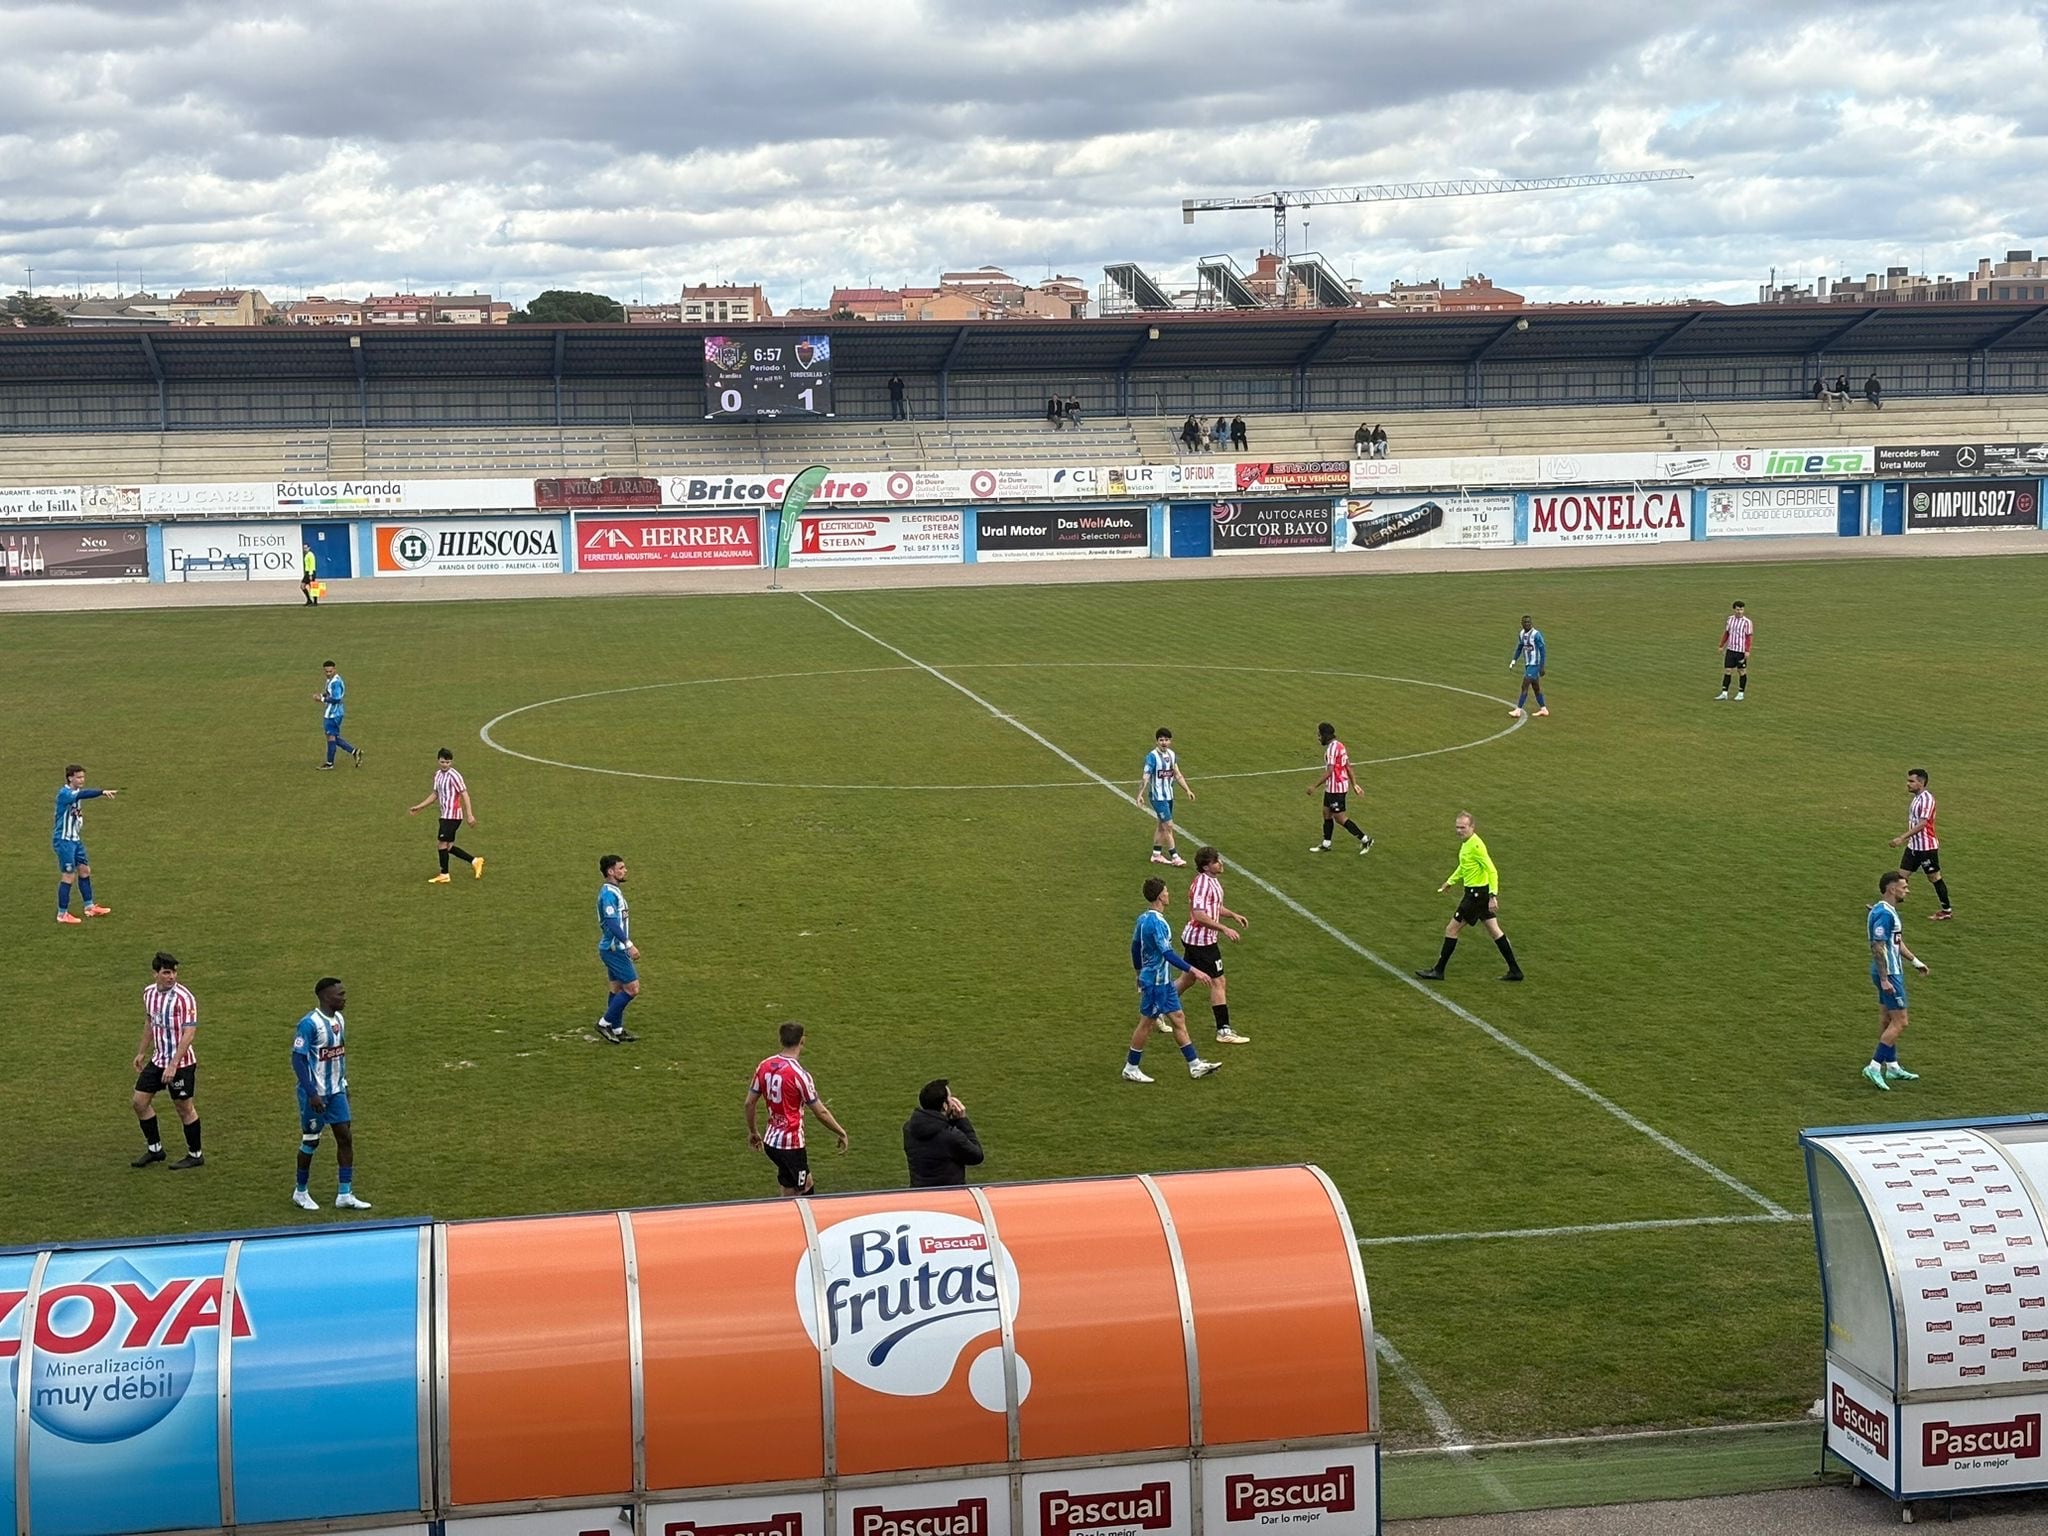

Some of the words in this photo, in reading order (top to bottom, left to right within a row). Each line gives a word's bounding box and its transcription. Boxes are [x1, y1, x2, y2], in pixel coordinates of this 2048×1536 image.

[754, 348, 782, 361] 6:57
[720, 390, 742, 412] 0
[797, 388, 813, 410] 1
[1880, 449, 1940, 458] Mercedes-Benz
[1765, 451, 1863, 474] imesa
[1880, 461, 1901, 470] Ureta
[1903, 460, 1926, 469] Motor
[277, 481, 337, 496] Rótulos
[343, 480, 401, 496] Aranda
[1264, 476, 1295, 484] ROTULA
[687, 478, 868, 500] BricoCtro
[1742, 490, 1771, 507] SAN
[1776, 488, 1835, 506] GABRIEL
[1931, 490, 2016, 518] IMPULSO27
[28, 501, 43, 512] de
[1257, 509, 1328, 520] AUTOCARES
[1532, 493, 1685, 533] MONELCA
[1742, 510, 1769, 520] CIUDAD
[1771, 510, 1780, 519] DE
[1782, 510, 1793, 519] LA
[1794, 508, 1835, 519] EDUCACIÓN
[901, 514, 959, 523] ELECTRICIDAD
[1057, 518, 1079, 529] Das
[1472, 511, 1487, 523] TÚ
[922, 523, 959, 532] ESTEBAN
[981, 525, 1007, 537] Ural
[1010, 525, 1047, 537] Motor
[1218, 523, 1280, 537] VICTOR
[1284, 521, 1328, 536] BAYO
[1364, 507, 1430, 546] HERNANDO
[437, 530, 558, 557] HIESCOSA
[640, 525, 752, 547] HERRERA
[902, 533, 930, 541] MAYOR
[932, 532, 960, 540] HERAS
[1058, 533, 1079, 541] Audi
[1081, 532, 1120, 541] Selection
[1259, 536, 1267, 545] El
[1268, 536, 1282, 547] lujo
[1300, 536, 1327, 544] servicio
[625, 551, 662, 561] INDUSTRIAL
[670, 551, 703, 560] ALQUILER
[704, 551, 713, 559] DE
[713, 550, 753, 558] MAQUINARIA
[438, 563, 465, 571] ARANDA
[764, 1072, 783, 1104] 19
[797, 1170, 806, 1186] 19
[850, 1224, 912, 1279] Bi
[924, 1235, 982, 1250] Pascual
[826, 1261, 999, 1346] frutas
[45, 1356, 165, 1378] Mineralización
[36, 1386, 98, 1412] muy
[103, 1374, 173, 1403] débil
[1835, 1391, 1886, 1447] Pascual
[1846, 1432, 1856, 1443] Dar
[1855, 1437, 1861, 1447] lo
[1860, 1441, 1874, 1456] mejor
[1931, 1421, 2033, 1455] Pascual
[1954, 1460, 1971, 1470] Dar
[1972, 1459, 1981, 1469] lo
[1983, 1458, 2010, 1471] mejor
[1235, 1473, 1346, 1509] Pascual
[1050, 1490, 1162, 1526] Pascual
[863, 1506, 979, 1536] Pascual
[1262, 1515, 1278, 1525] Dar
[1281, 1513, 1291, 1524] lo
[1292, 1511, 1321, 1525] mejor
